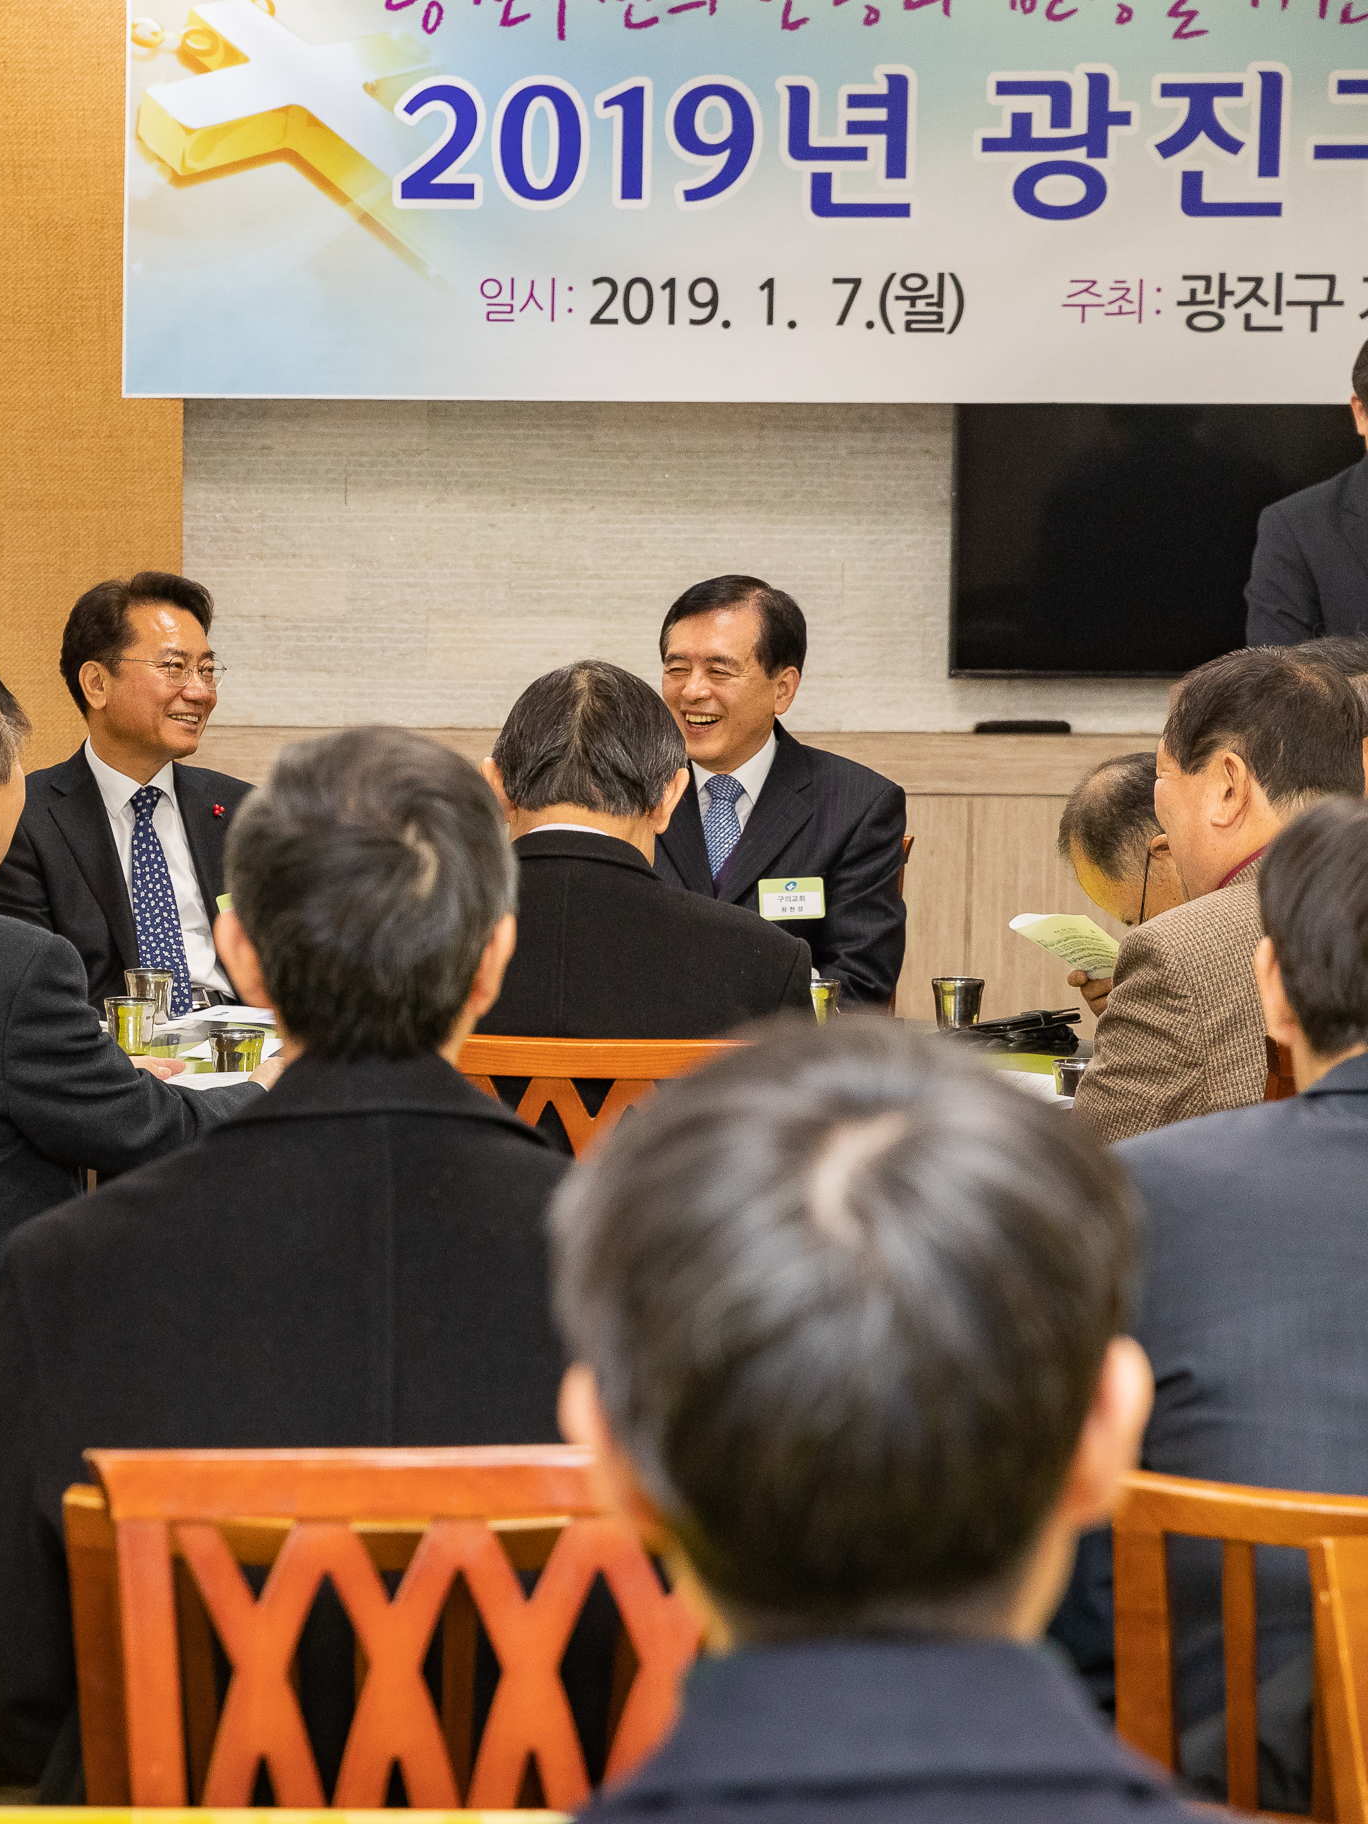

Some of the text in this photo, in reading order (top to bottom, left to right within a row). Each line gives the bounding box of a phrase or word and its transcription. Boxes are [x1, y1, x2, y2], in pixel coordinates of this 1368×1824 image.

[399, 71, 912, 219] 2019년
[479, 271, 966, 335] 일시: 2019. 1. 7.(월)
[1061, 278, 1162, 325] 주최:
[1175, 271, 1345, 333] 광진구
